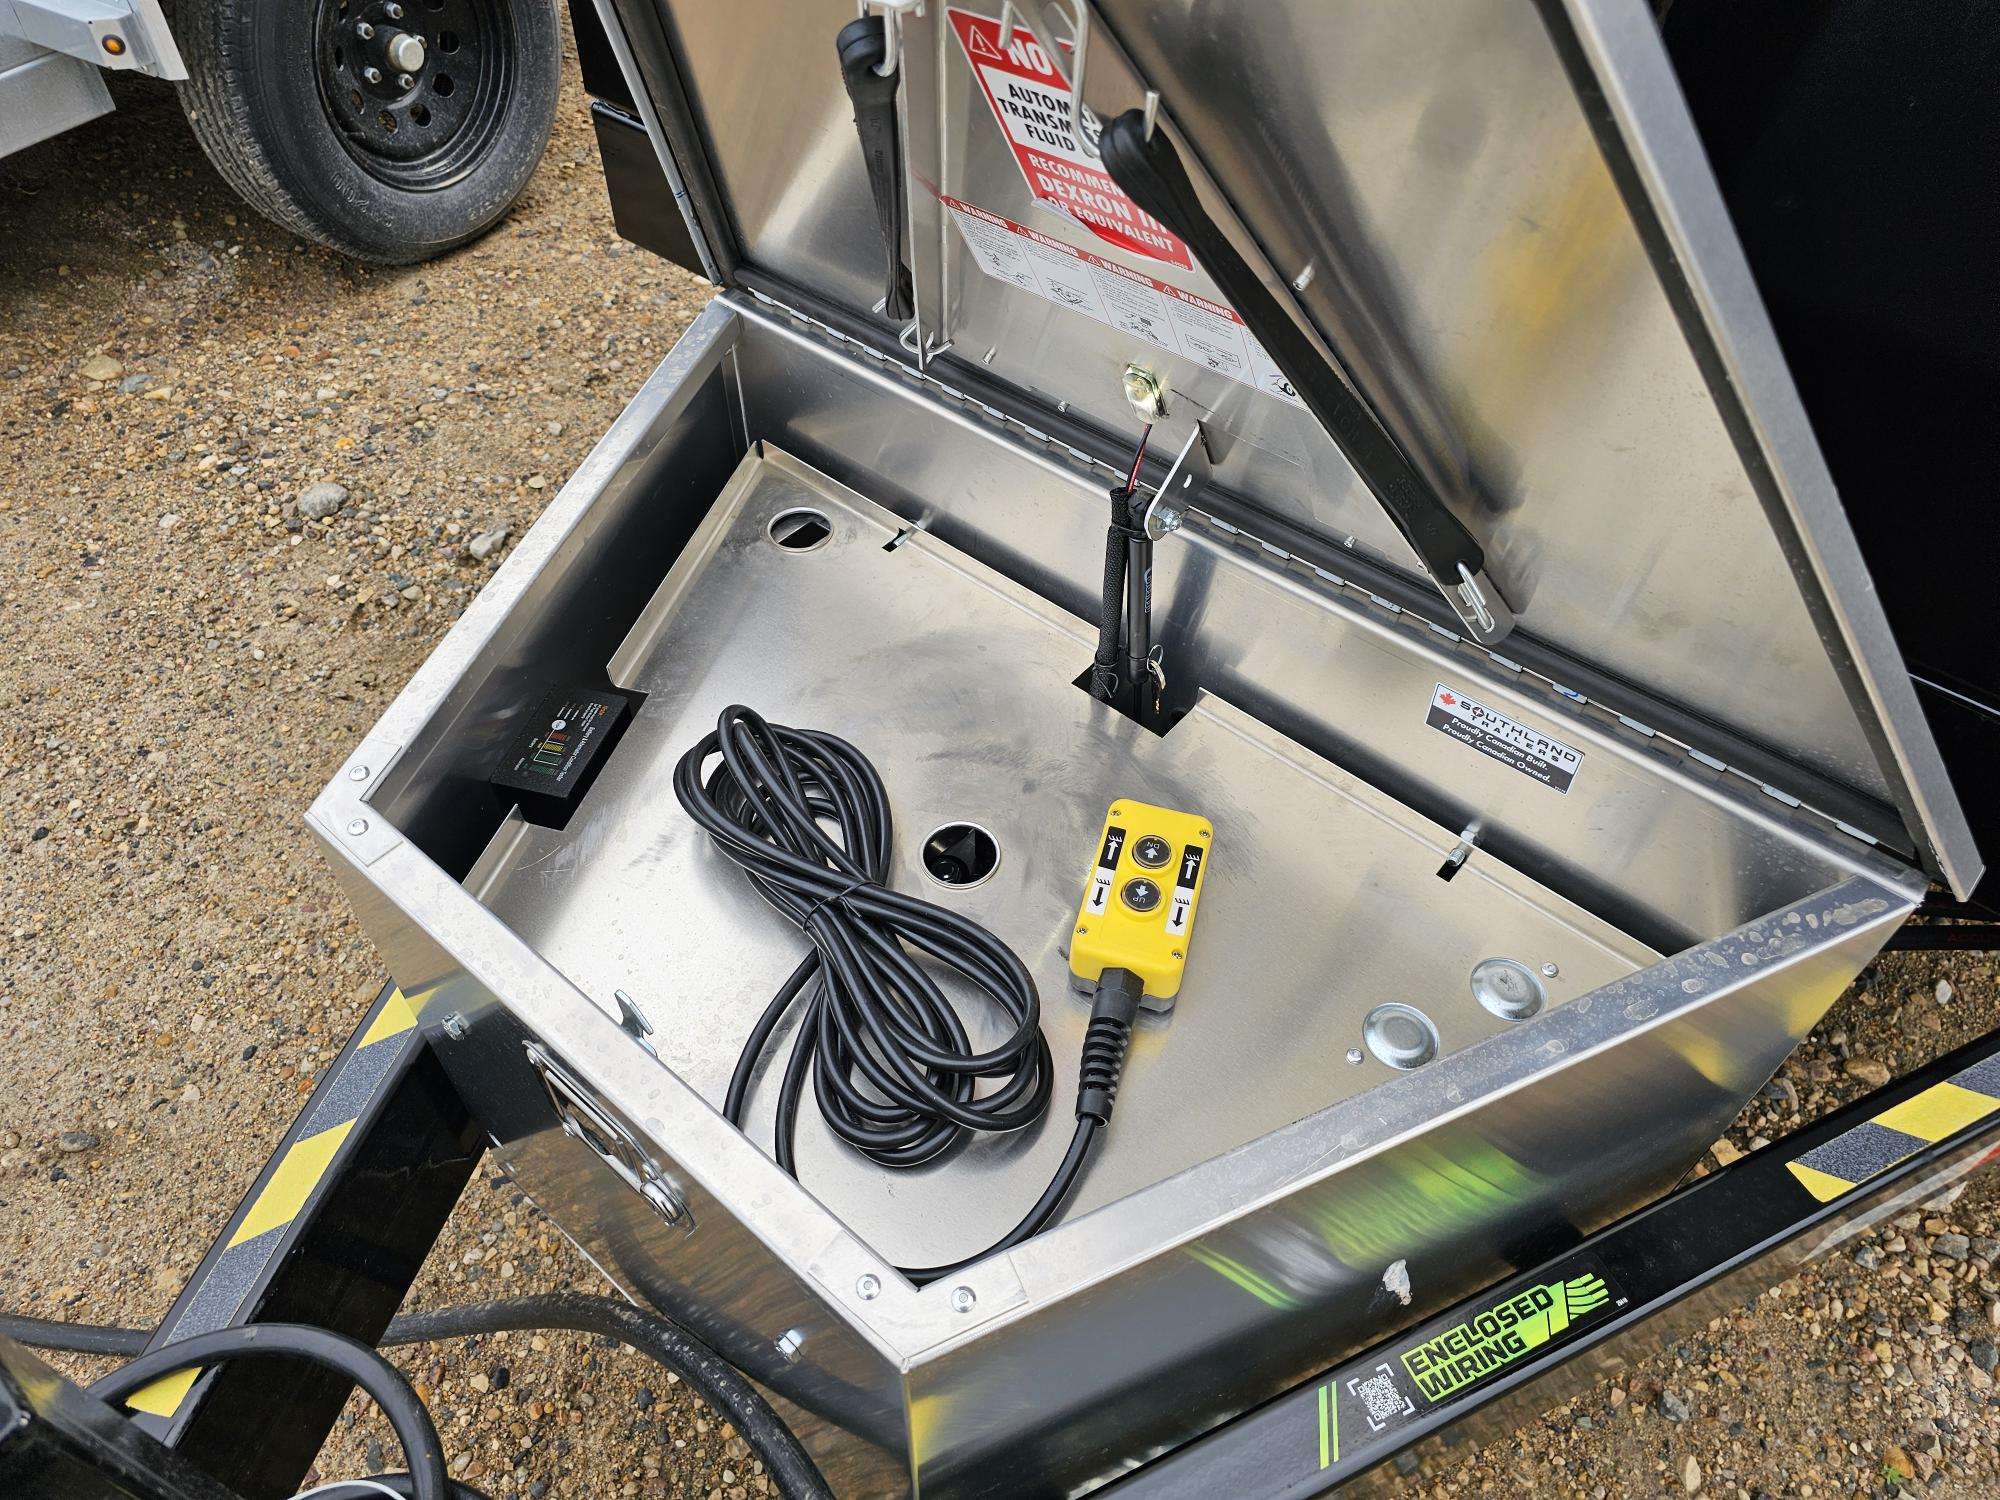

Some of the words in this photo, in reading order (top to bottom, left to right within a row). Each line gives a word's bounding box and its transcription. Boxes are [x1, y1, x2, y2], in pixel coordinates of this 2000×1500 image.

[1007, 38, 1053, 76] NO
[1024, 123, 1076, 151] FLUID
[960, 202, 1008, 229] WARNING
[1036, 172, 1133, 221] DEXRON
[1028, 230, 1079, 257] WARNING
[1074, 205, 1174, 252] EQUIVALENT
[1101, 259, 1154, 287] WARNING
[1177, 290, 1233, 319] WARNING
[1443, 723, 1475, 744] Proudly
[1476, 741, 1515, 764] Canadian
[1516, 761, 1551, 783] Owned.
[1452, 717, 1484, 738] Proudly
[1485, 734, 1525, 758] Canadian
[1526, 754, 1549, 770] Built.
[1461, 700, 1576, 762] SOUTHLAND
[1470, 714, 1559, 762] TRAILERS
[1419, 1330, 1528, 1398] WIRING
